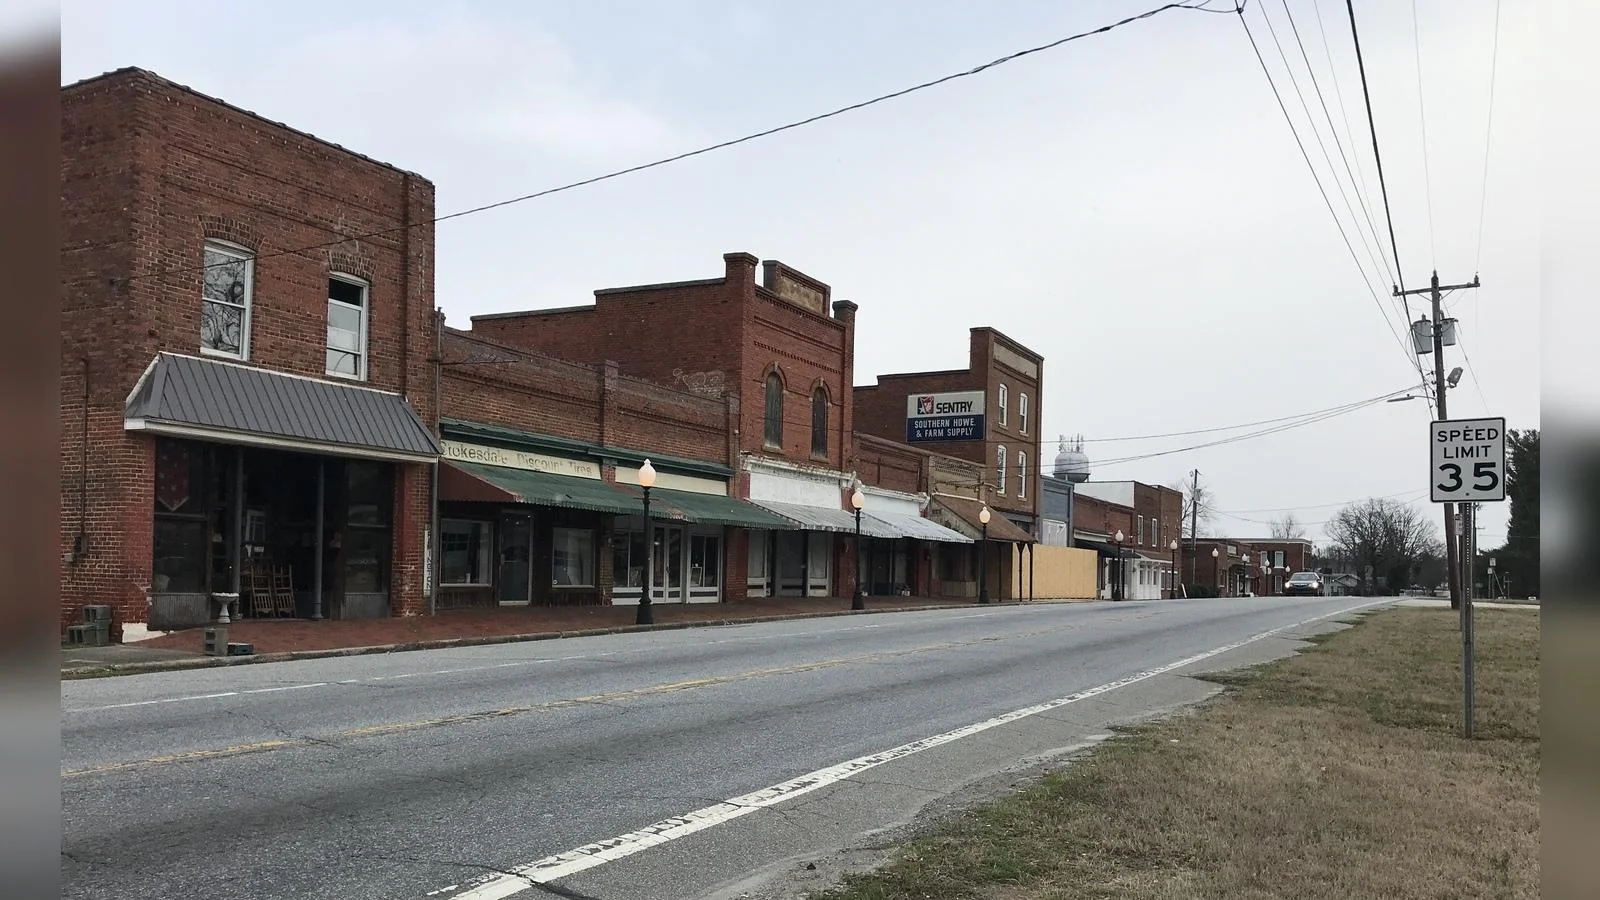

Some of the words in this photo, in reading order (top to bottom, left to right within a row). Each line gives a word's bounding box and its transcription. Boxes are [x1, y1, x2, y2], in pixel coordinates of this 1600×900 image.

[936, 401, 973, 414] SENTRY
[914, 420, 950, 429] SOUTHERN
[916, 430, 922, 438] &
[925, 429, 944, 437] FARM
[947, 428, 973, 436] SUPPLY
[1437, 428, 1499, 442] SPEED
[1443, 445, 1492, 459] LIMIT
[1437, 462, 1499, 493] 35
